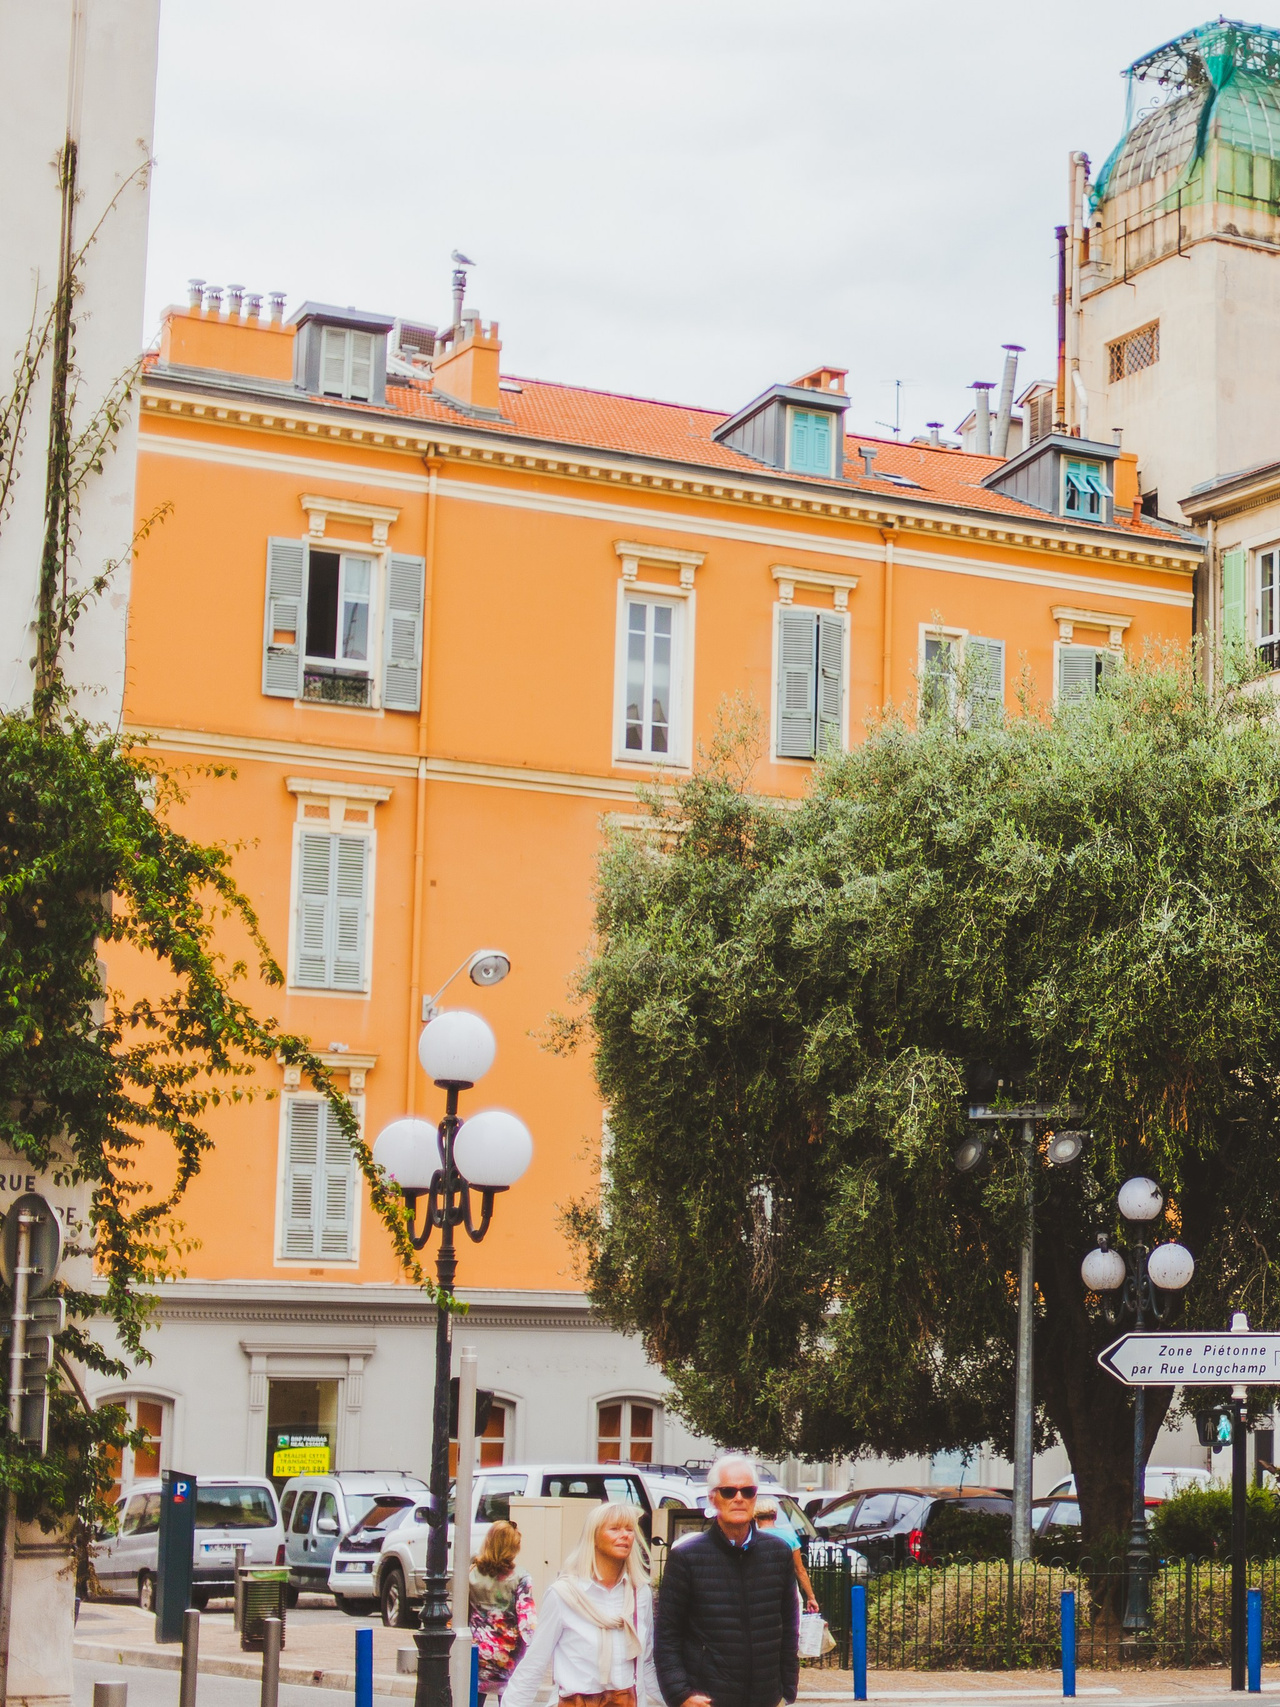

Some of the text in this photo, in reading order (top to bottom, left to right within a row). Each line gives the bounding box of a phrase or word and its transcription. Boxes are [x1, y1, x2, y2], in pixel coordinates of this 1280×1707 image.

[1159, 1344, 1267, 1356] Zone Piétonne
[1131, 1363, 1267, 1377] par Rue Longchamp
[177, 1482, 187, 1495] P
